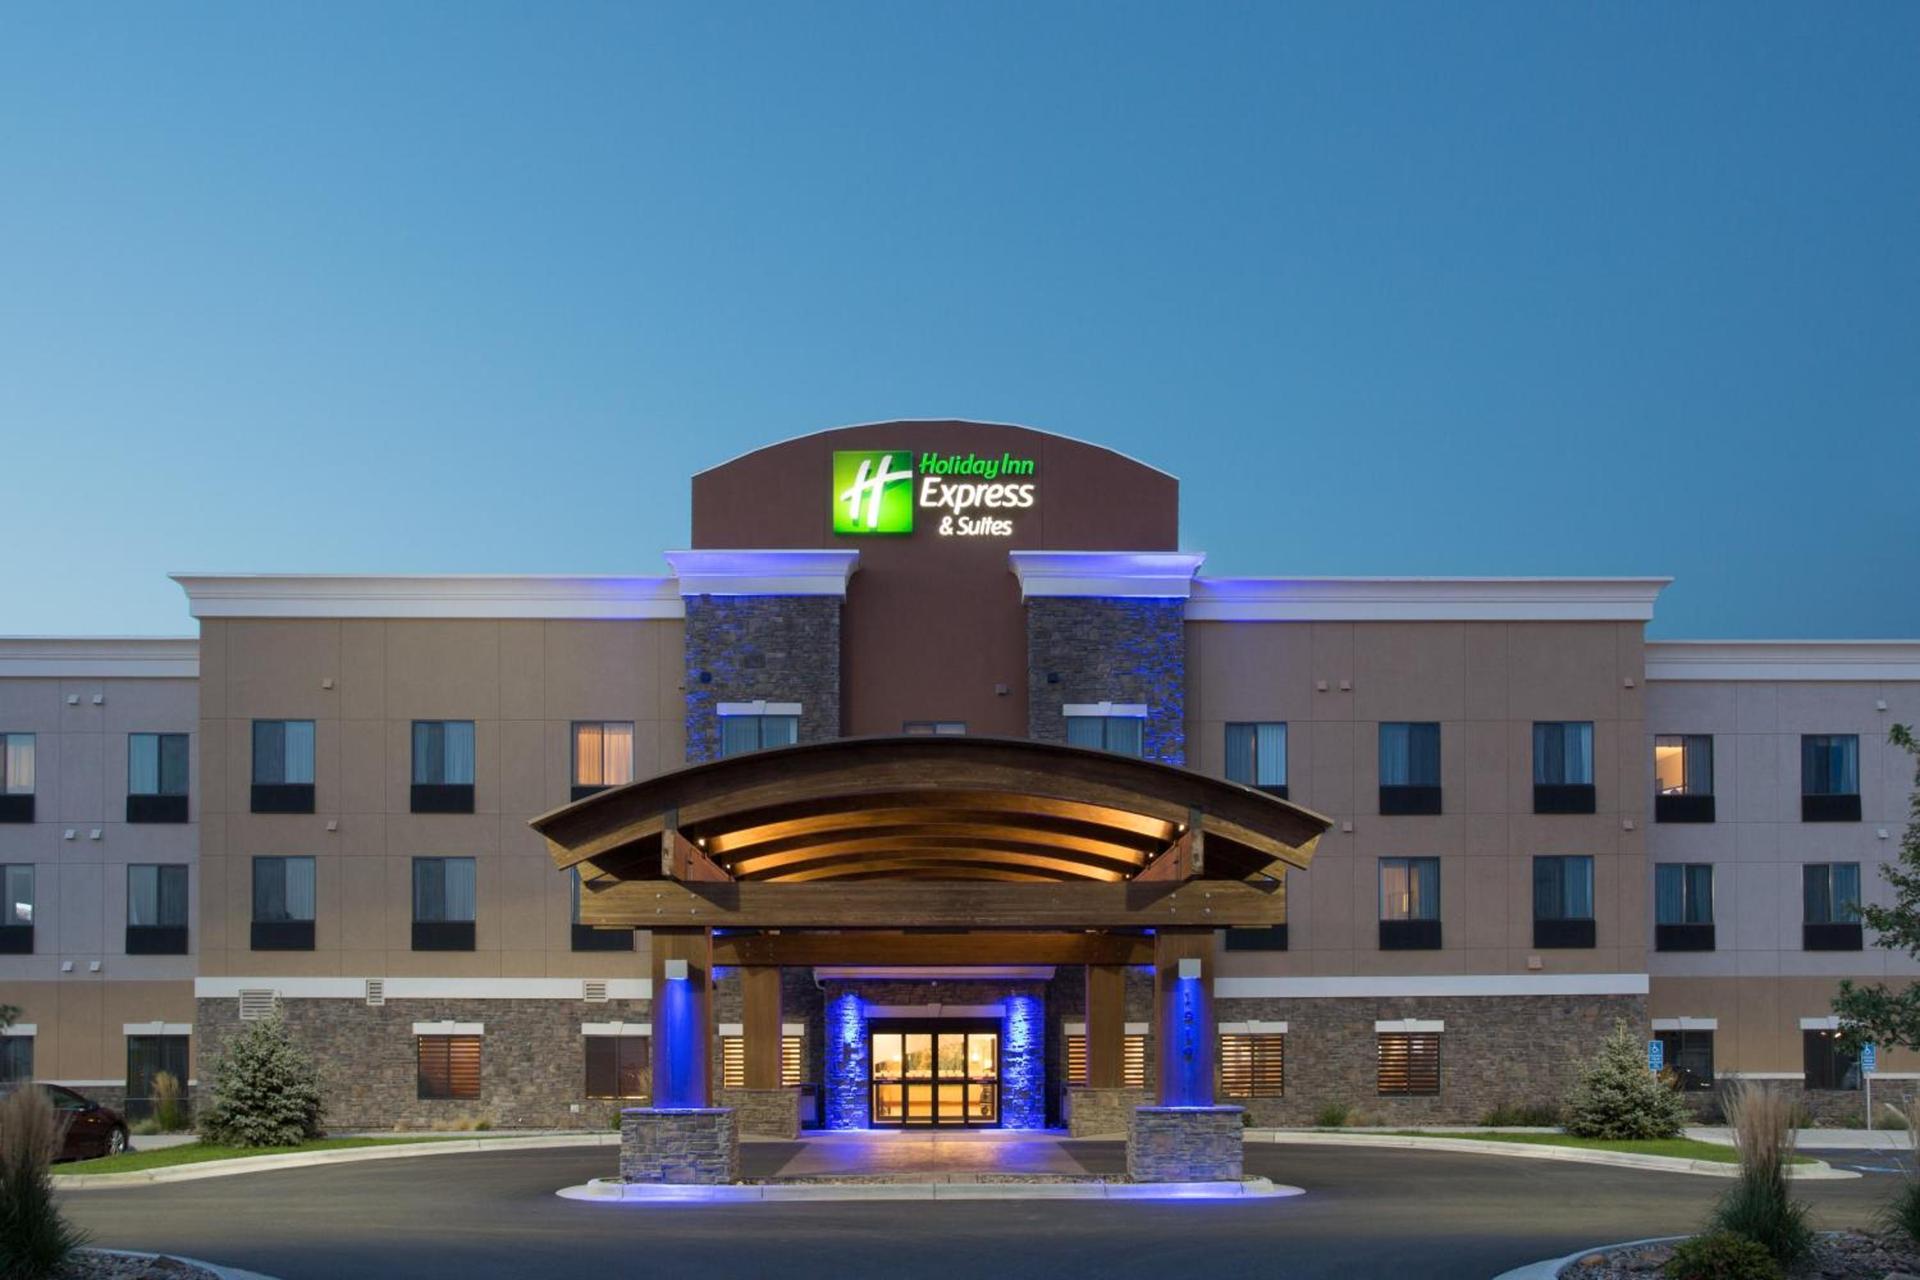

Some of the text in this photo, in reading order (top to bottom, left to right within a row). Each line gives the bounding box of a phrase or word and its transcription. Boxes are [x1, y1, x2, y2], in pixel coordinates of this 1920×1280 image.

[919, 453, 1034, 479] Holiday Inn
[840, 455, 912, 528] H
[919, 477, 1034, 515] Express
[938, 516, 1012, 536] & Suites
